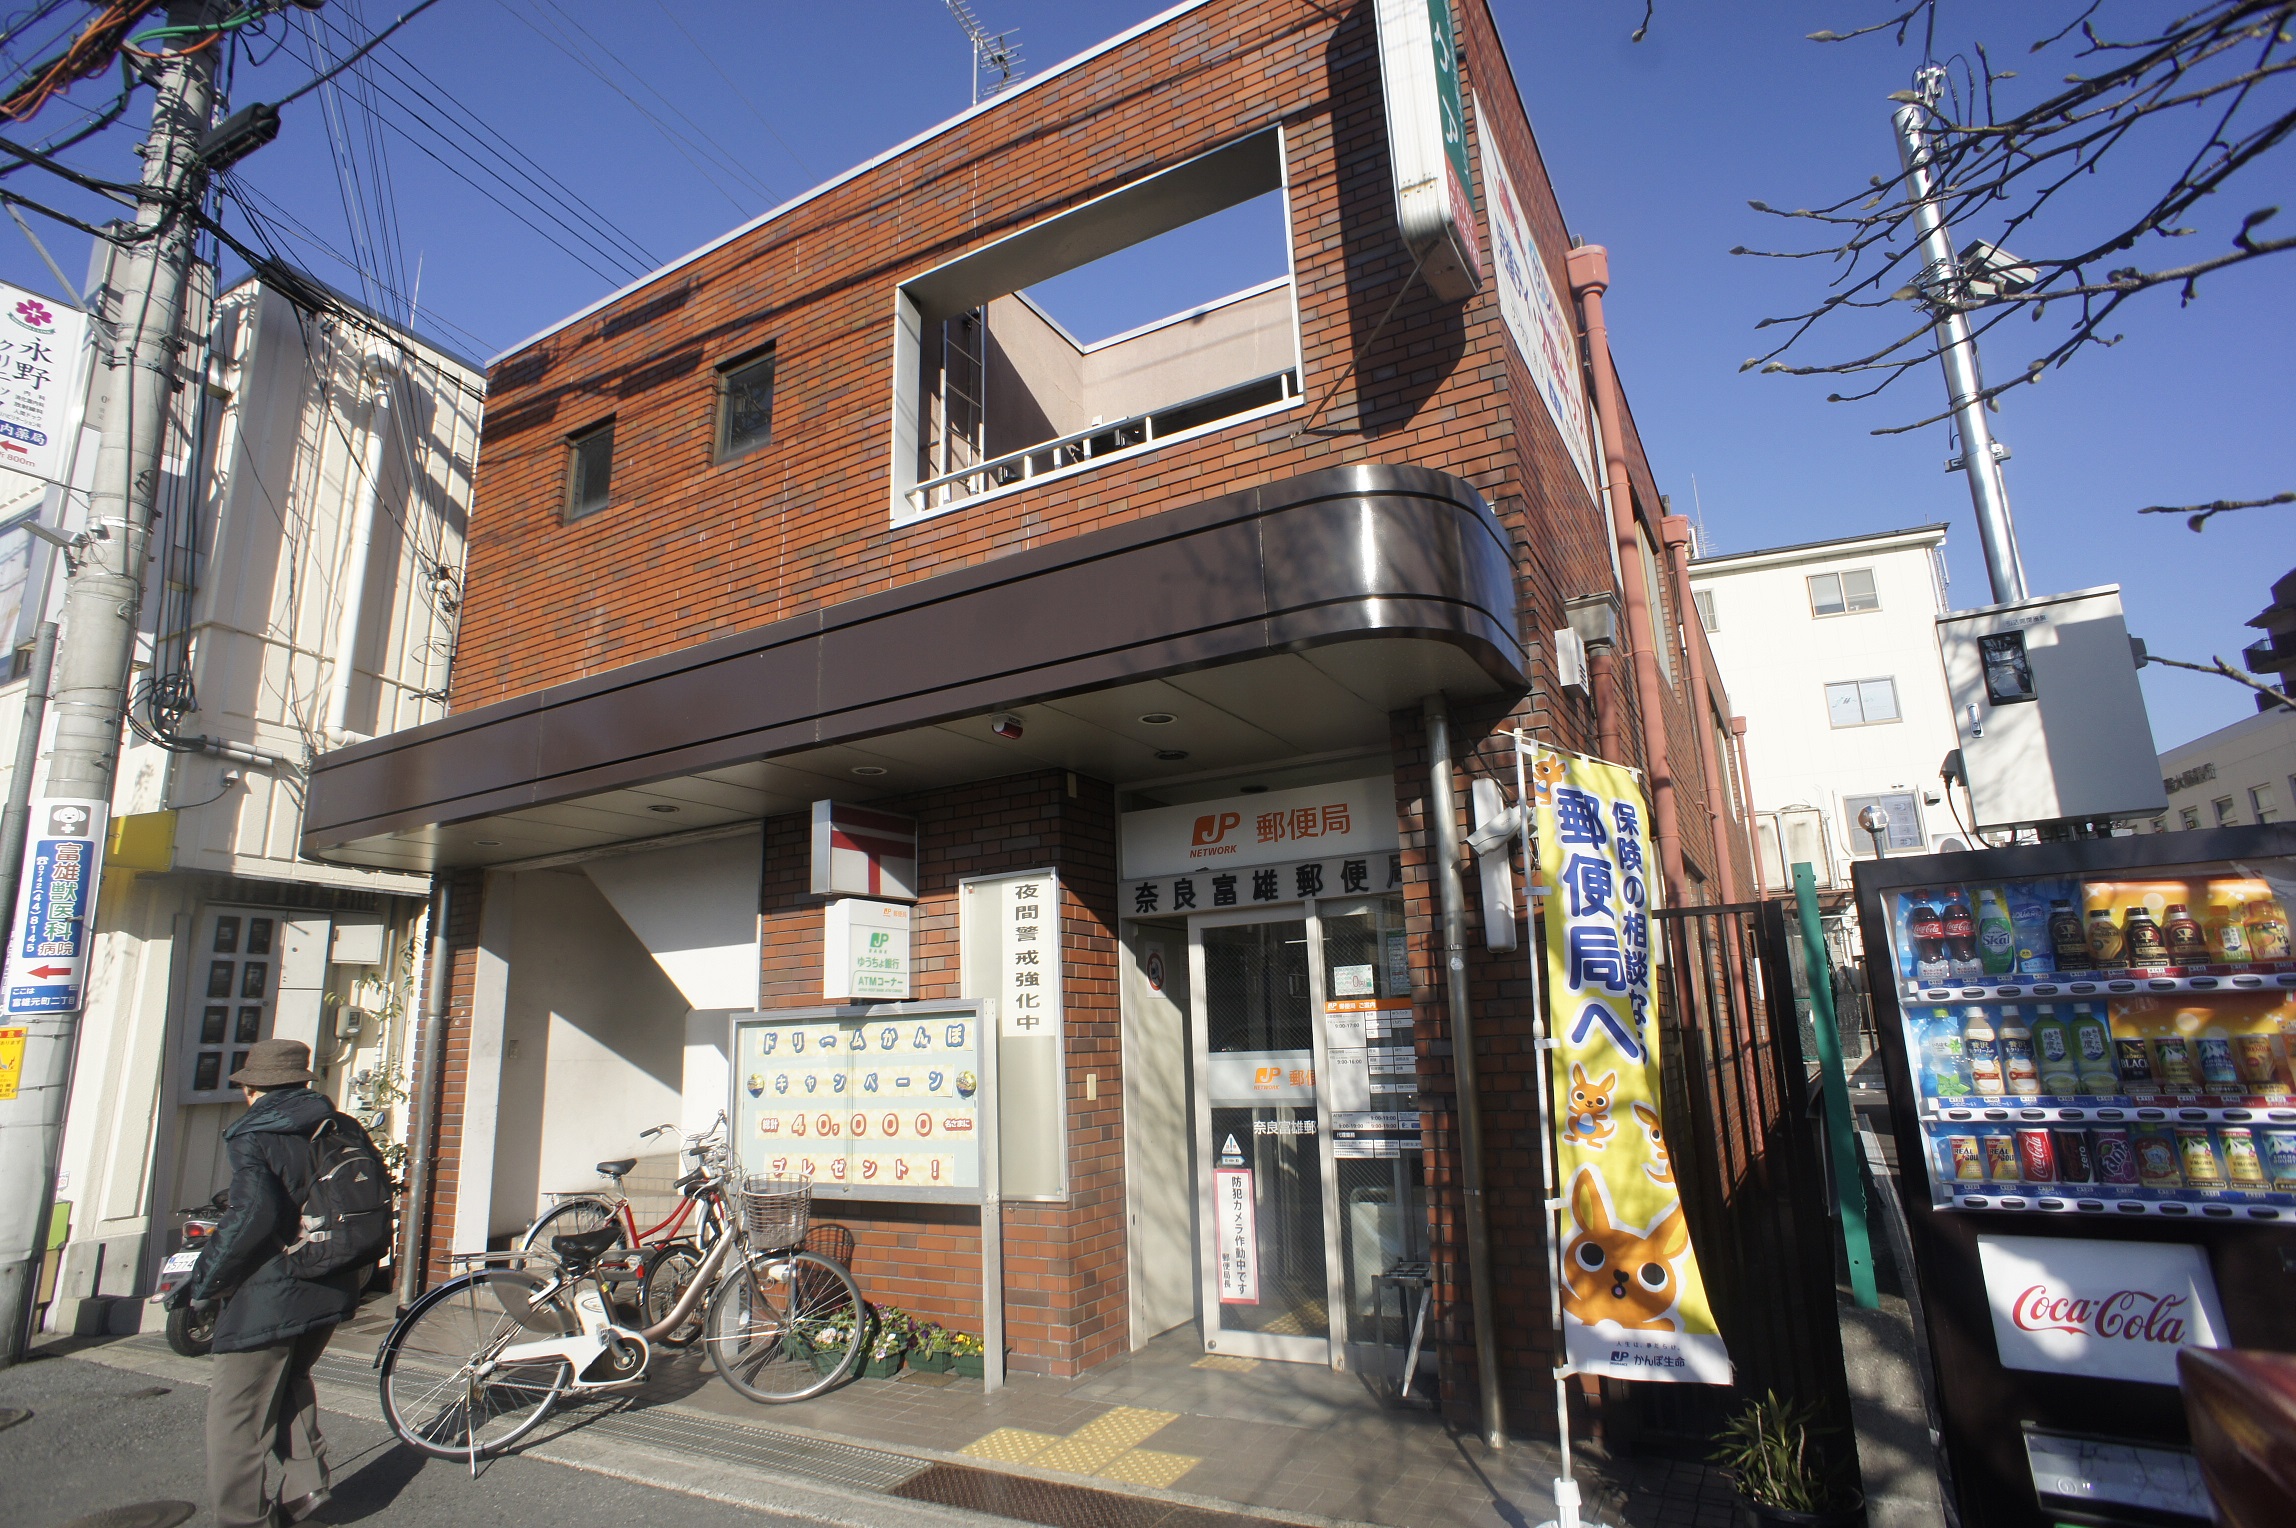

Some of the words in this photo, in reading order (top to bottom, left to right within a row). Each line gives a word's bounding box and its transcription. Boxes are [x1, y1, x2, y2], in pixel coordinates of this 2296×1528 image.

[12, 336, 54, 390] 永野
[1191, 812, 1241, 846] JP
[1256, 803, 1351, 844] 郵便局
[1189, 844, 1238, 858] NETWORK
[37, 842, 83, 957] 富雄獣医科病院
[1556, 787, 1639, 1059] 郵便局へ
[1914, 922, 1939, 934] Coca-Cola
[1946, 920, 1971, 932] Coca-Cola
[857, 957, 900, 970] ゆうちょ銀行
[1014, 884, 1041, 1031] 夜間警戒強化中
[12, 987, 35, 995] ここは
[857, 976, 903, 987] ATMコーナー
[12, 996, 76, 1007] 富雄元町二丁目
[763, 1023, 966, 1055] ドリームかんぽ
[775, 1070, 944, 1094] キャンペーン
[1953, 1147, 1974, 1155] REAL
[1989, 1147, 2010, 1155] REAL
[2079, 1146, 2089, 1169] zero
[1231, 1176, 1247, 1295] 防犯カメラ作動中です
[1222, 1252, 1231, 1288] 郵便局長
[2012, 1285, 2188, 1344] Coca-Cola
[1634, 1354, 1685, 1368] かんぽ生命
